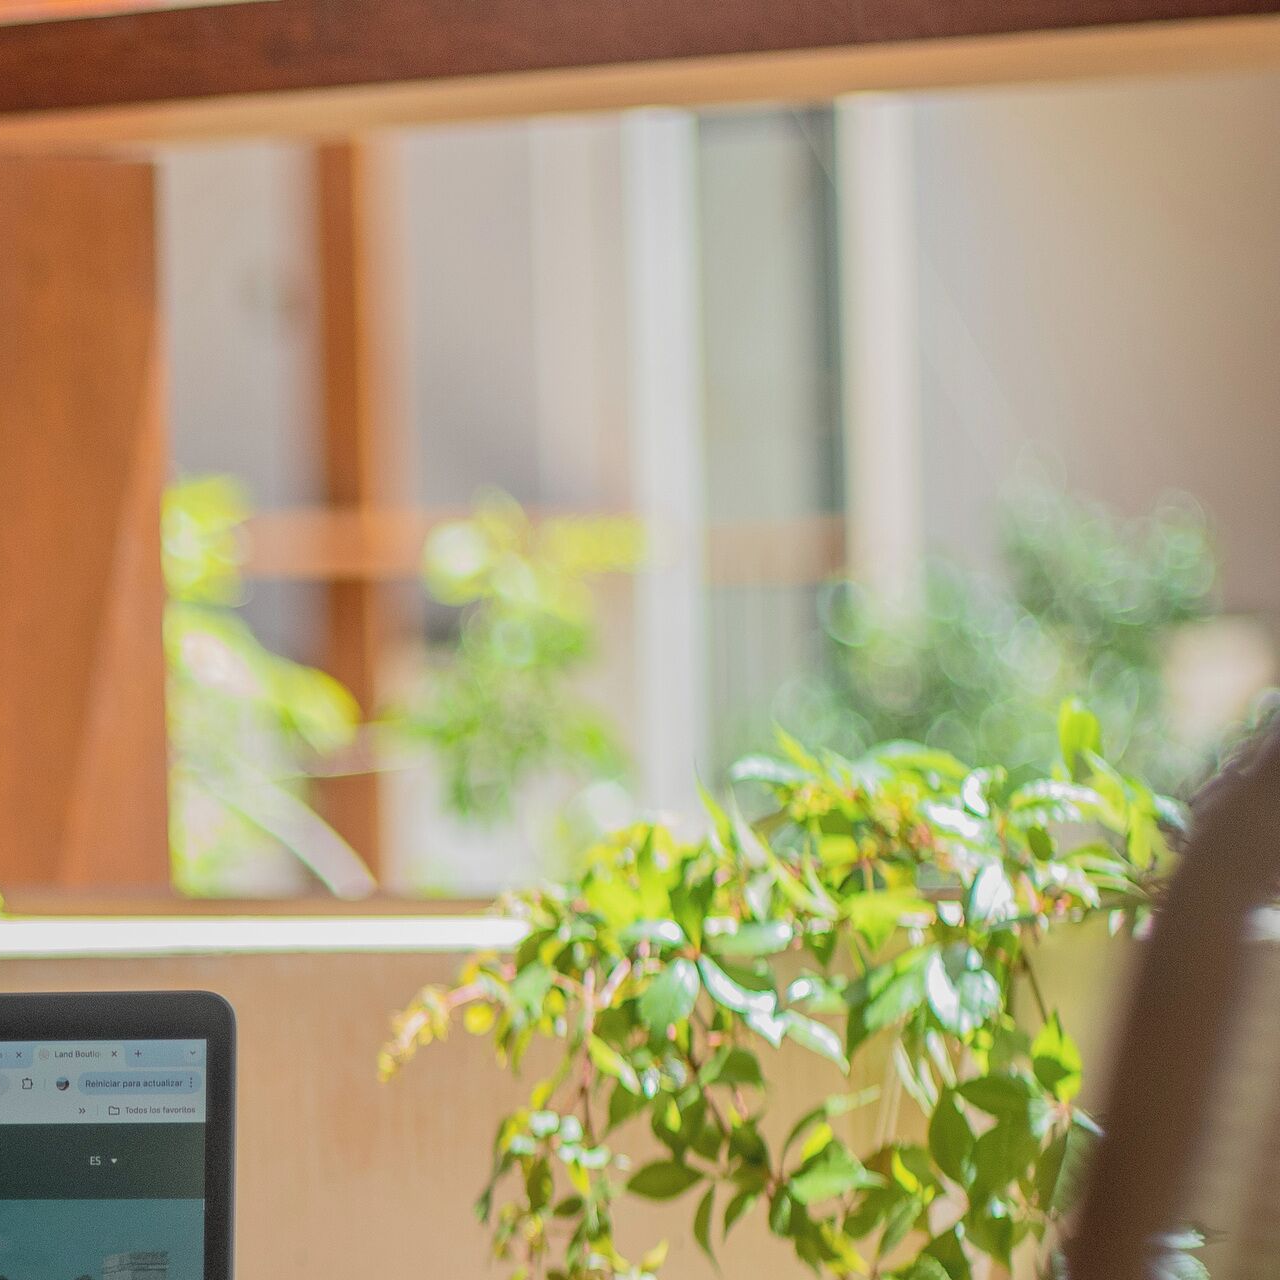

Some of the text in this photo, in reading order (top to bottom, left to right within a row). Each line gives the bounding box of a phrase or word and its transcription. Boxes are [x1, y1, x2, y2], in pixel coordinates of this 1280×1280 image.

[54, 1050, 74, 1058] Land
[85, 1079, 183, 1089] Reiniciar para actualizar
[125, 1106, 196, 1114] Todos los favoritos
[90, 1156, 101, 1166] ES
